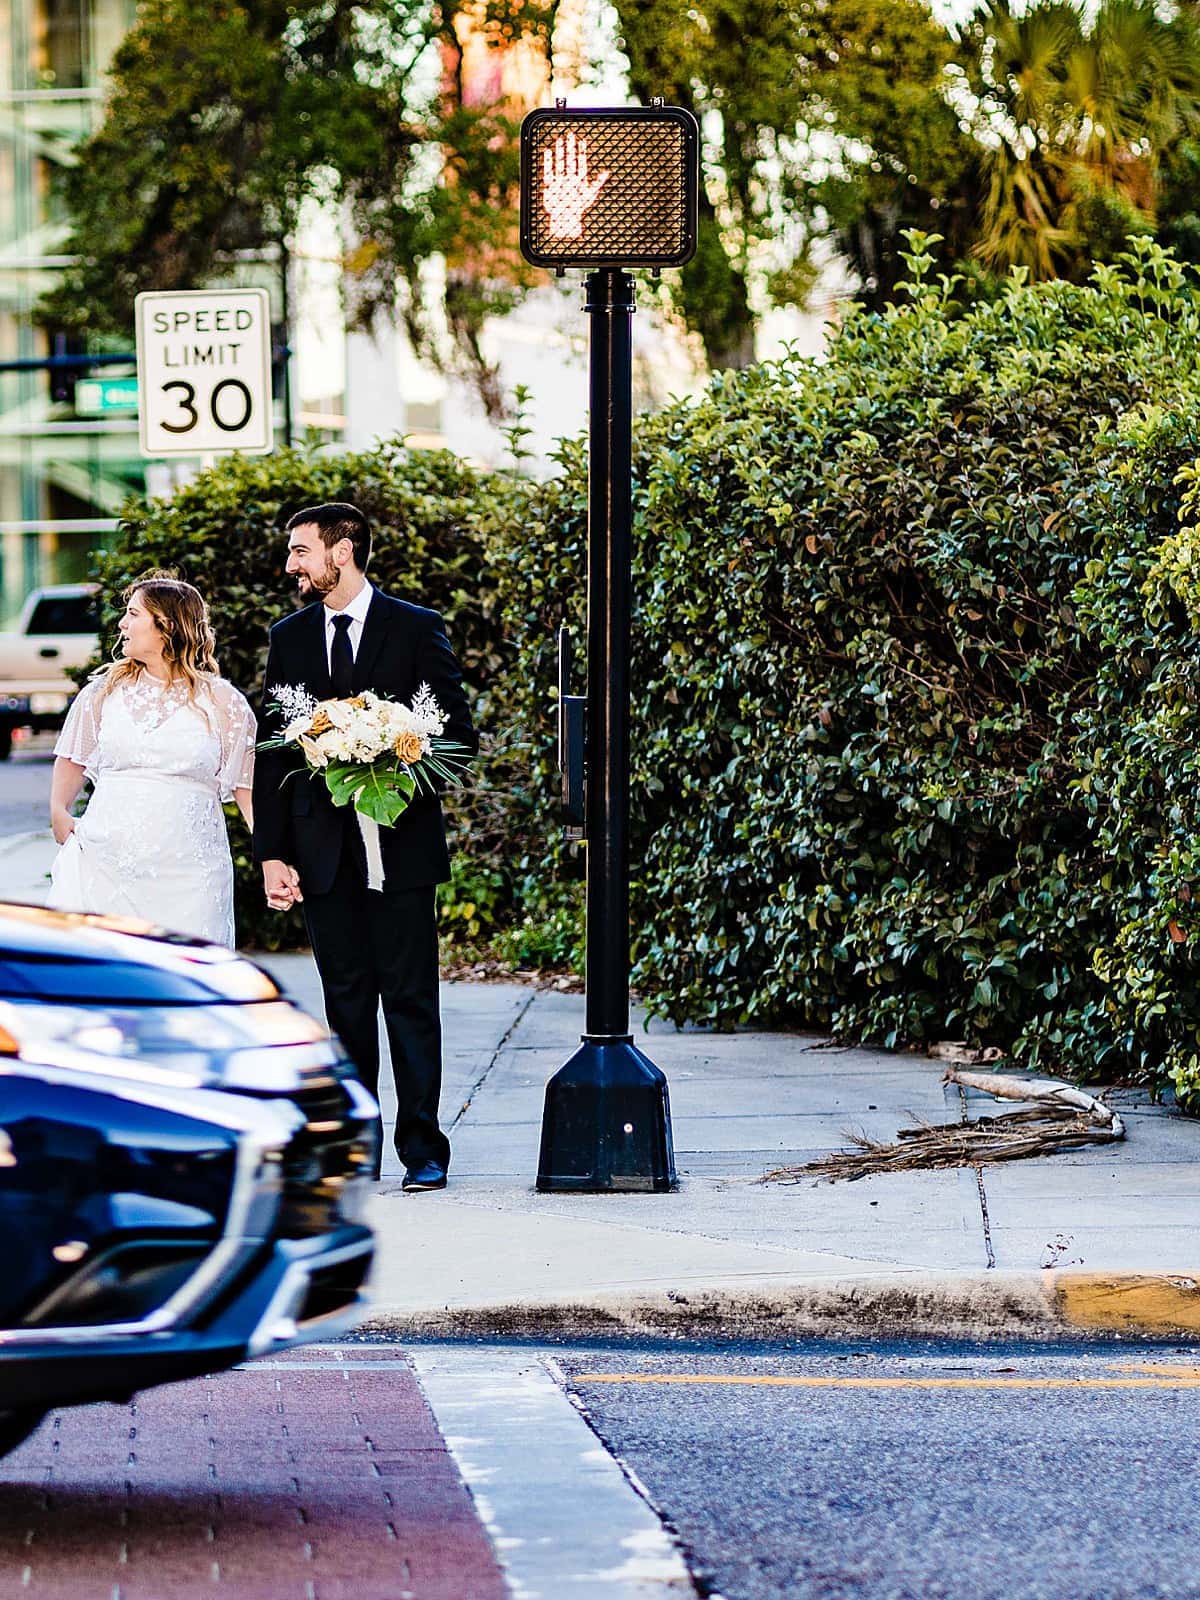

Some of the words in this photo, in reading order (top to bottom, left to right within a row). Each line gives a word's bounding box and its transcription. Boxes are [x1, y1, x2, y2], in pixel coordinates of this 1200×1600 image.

[153, 309, 253, 333] SPEED
[164, 343, 242, 367] LIMIT
[160, 378, 253, 433] 30
